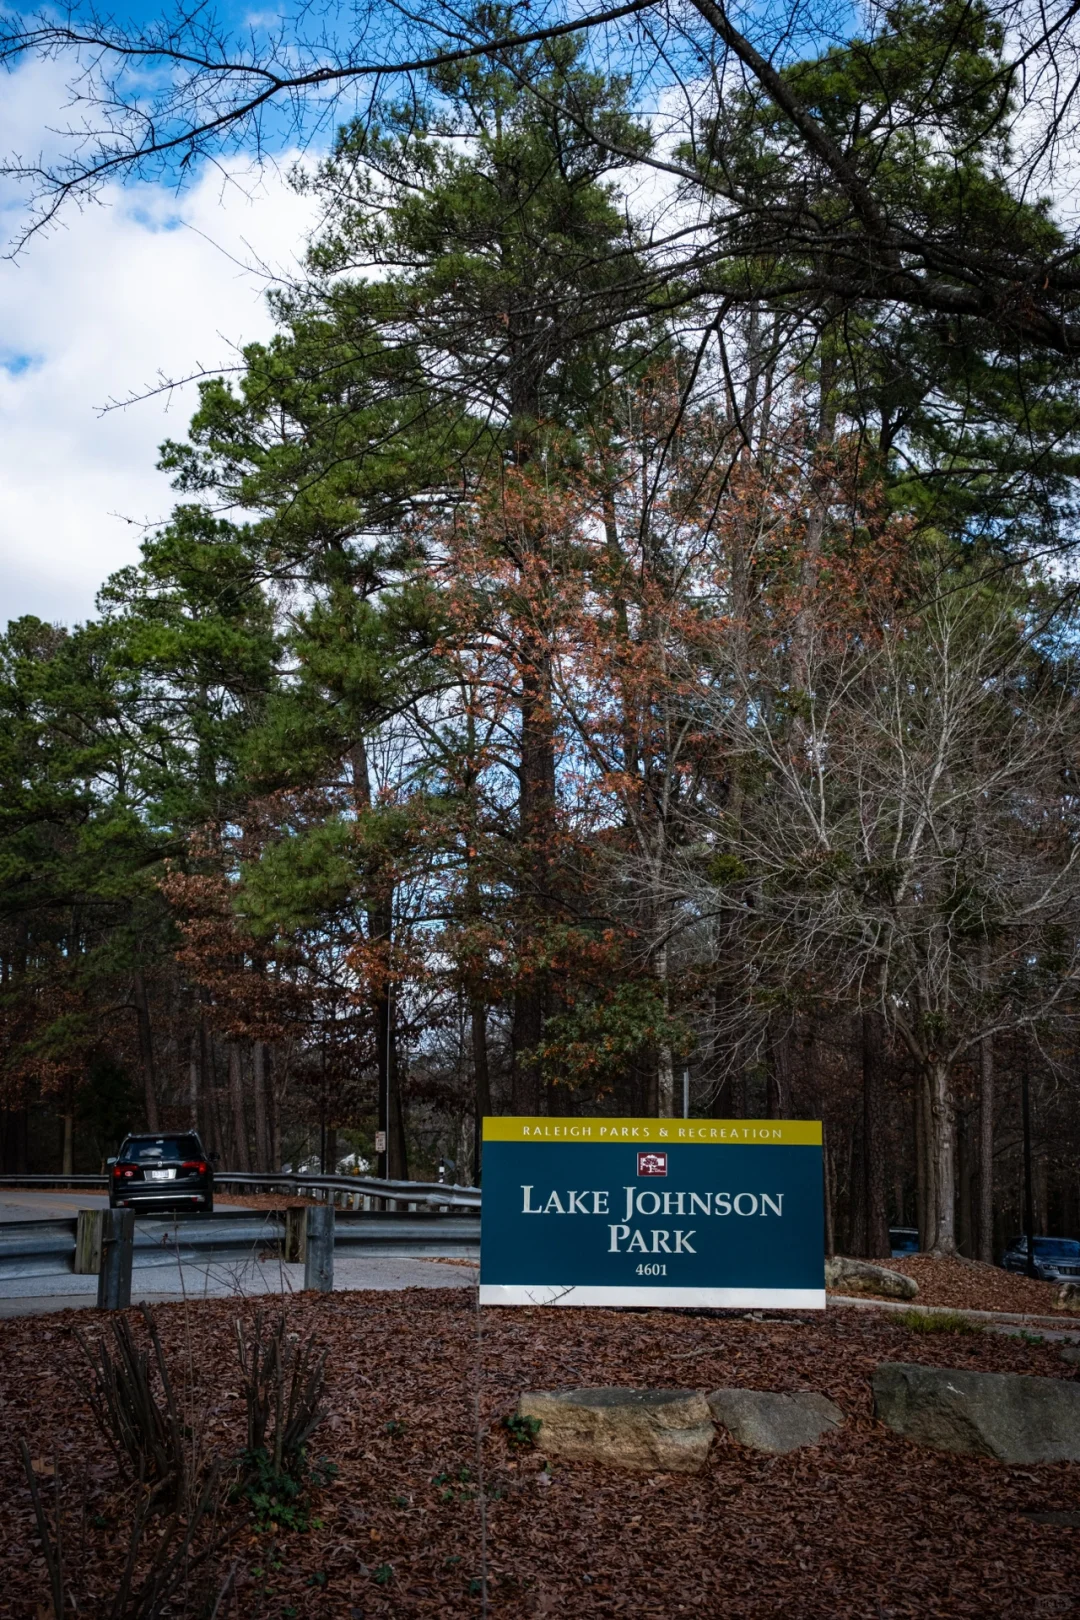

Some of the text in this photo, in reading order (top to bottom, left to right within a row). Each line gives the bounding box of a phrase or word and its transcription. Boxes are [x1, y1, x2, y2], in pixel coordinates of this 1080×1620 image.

[523, 1126, 783, 1139] RALEIGH PARKS & RECREATION
[520, 1185, 784, 1223] LAKE JOHNSON
[607, 1224, 697, 1254] PARK
[635, 1263, 668, 1276] 4601
